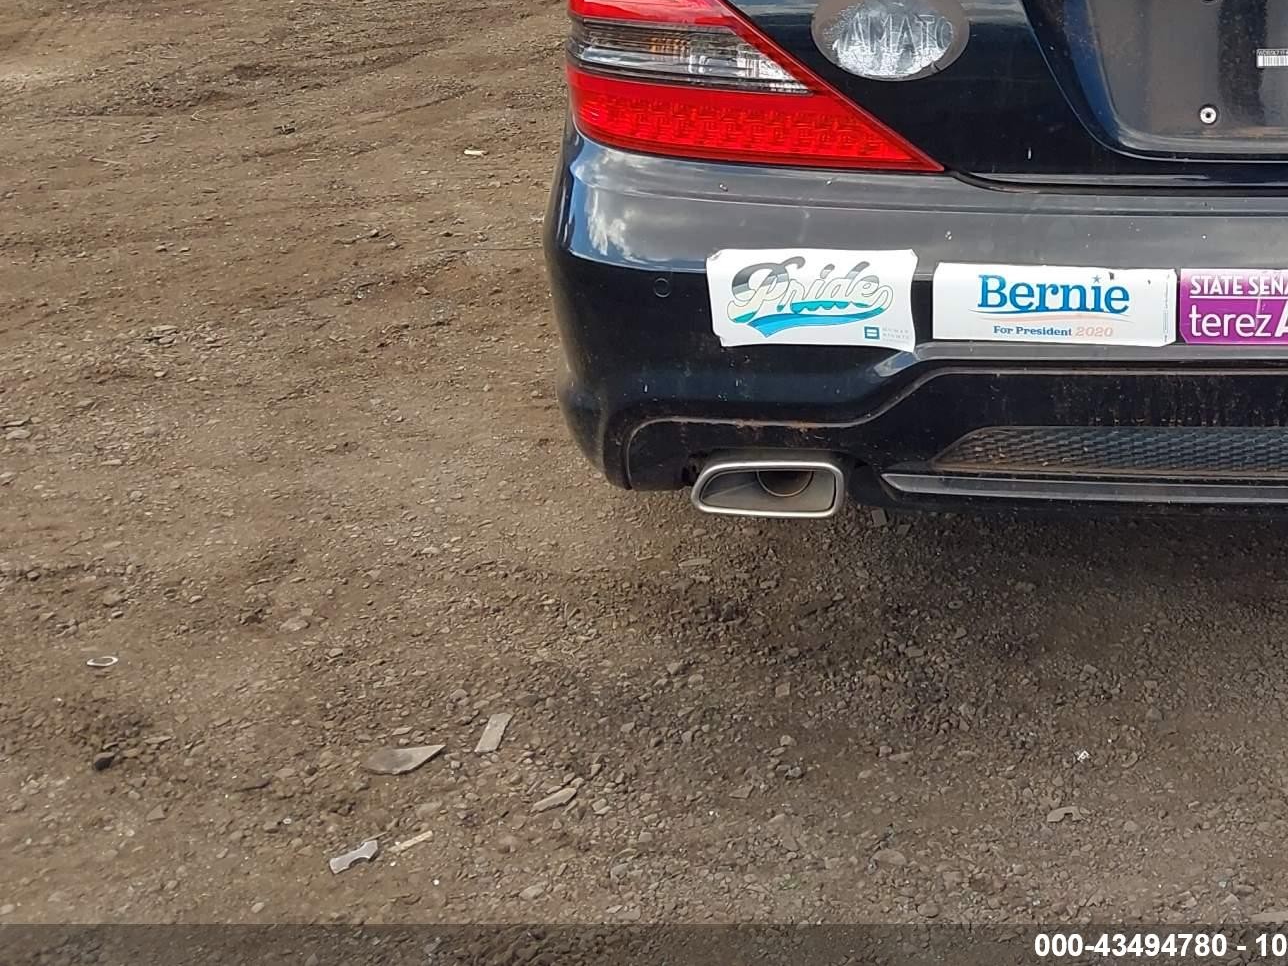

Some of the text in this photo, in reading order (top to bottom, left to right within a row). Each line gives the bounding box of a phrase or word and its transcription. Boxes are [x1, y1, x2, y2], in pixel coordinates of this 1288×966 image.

[727, 256, 894, 326] Pride
[977, 274, 1130, 314] Bernie
[1190, 275, 1244, 295] STATE
[993, 325, 1113, 337] For President 2020
